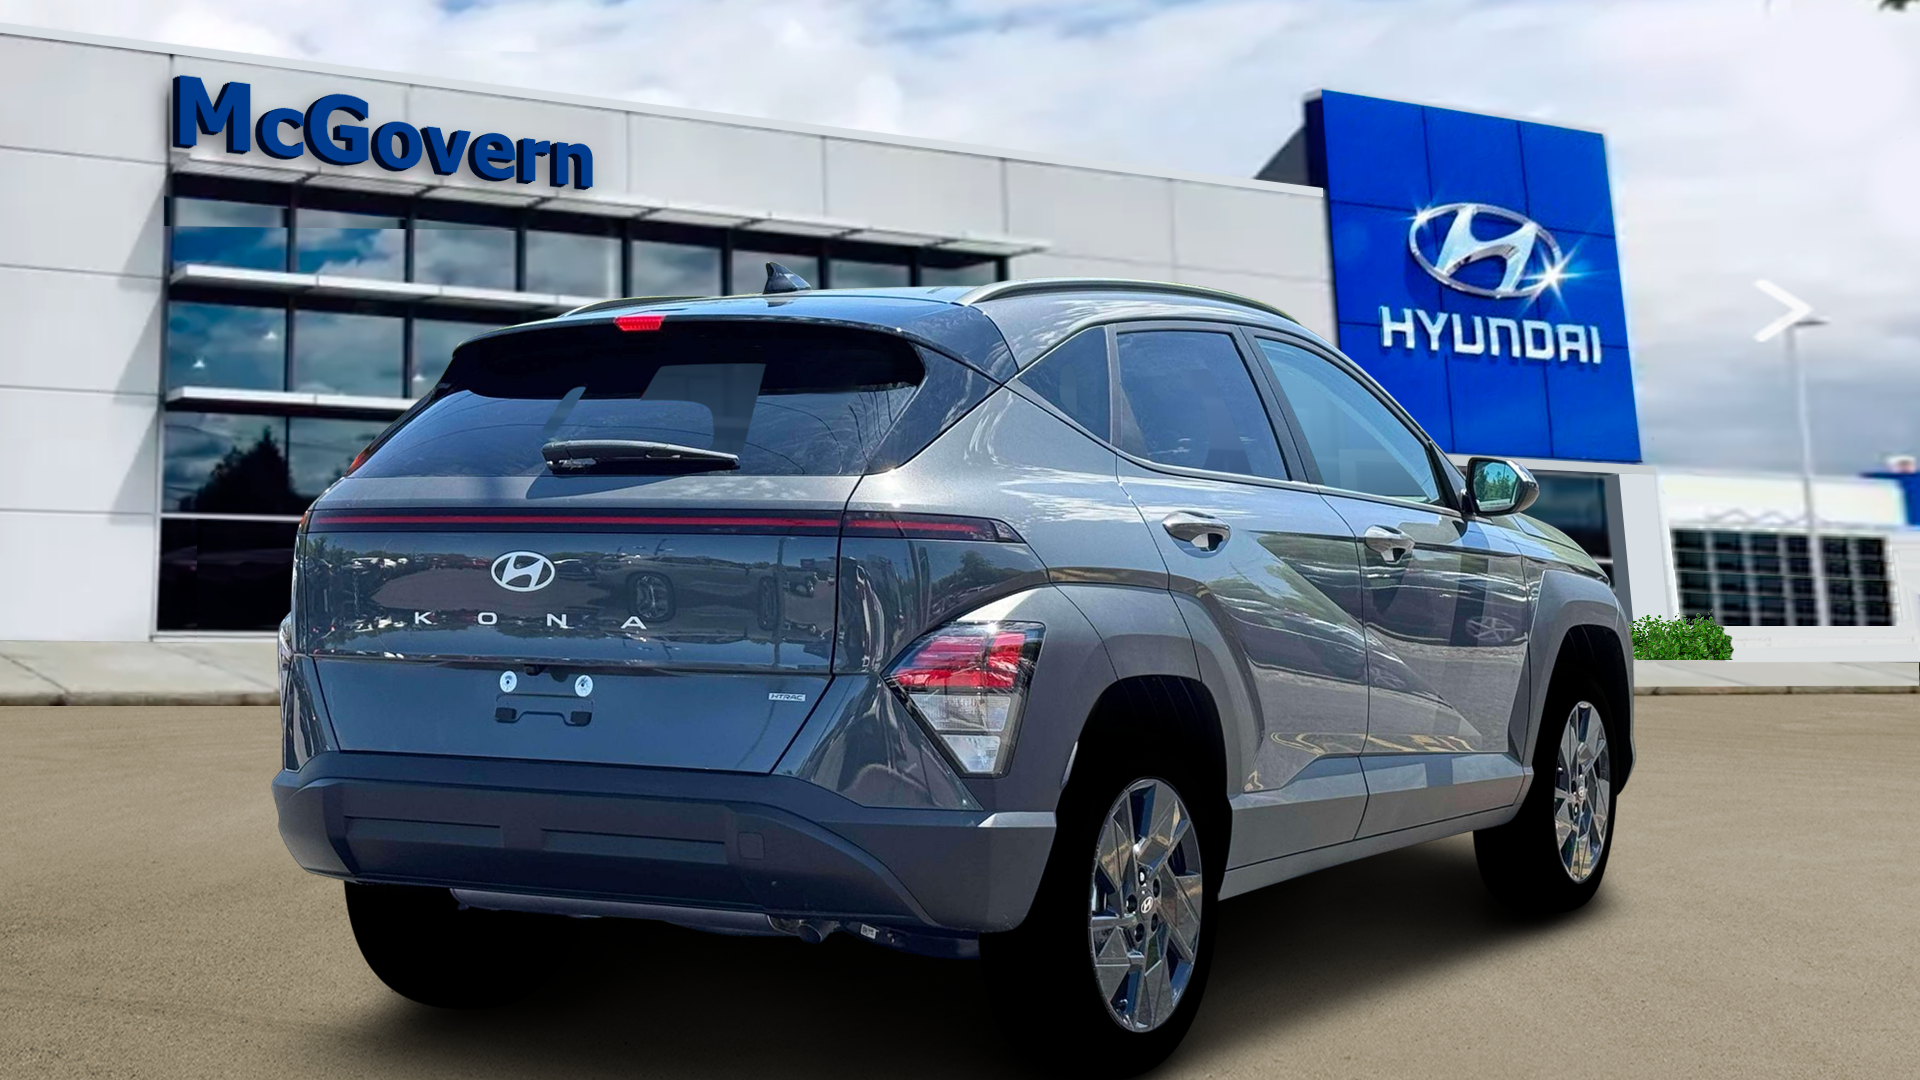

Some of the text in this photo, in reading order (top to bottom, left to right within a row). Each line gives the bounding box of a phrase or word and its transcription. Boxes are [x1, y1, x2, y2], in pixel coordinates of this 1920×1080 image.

[172, 75, 593, 189] McGovern
[1379, 306, 1601, 363] HYUNDAI
[414, 611, 647, 629] KONA
[769, 693, 805, 701] HTRAC
